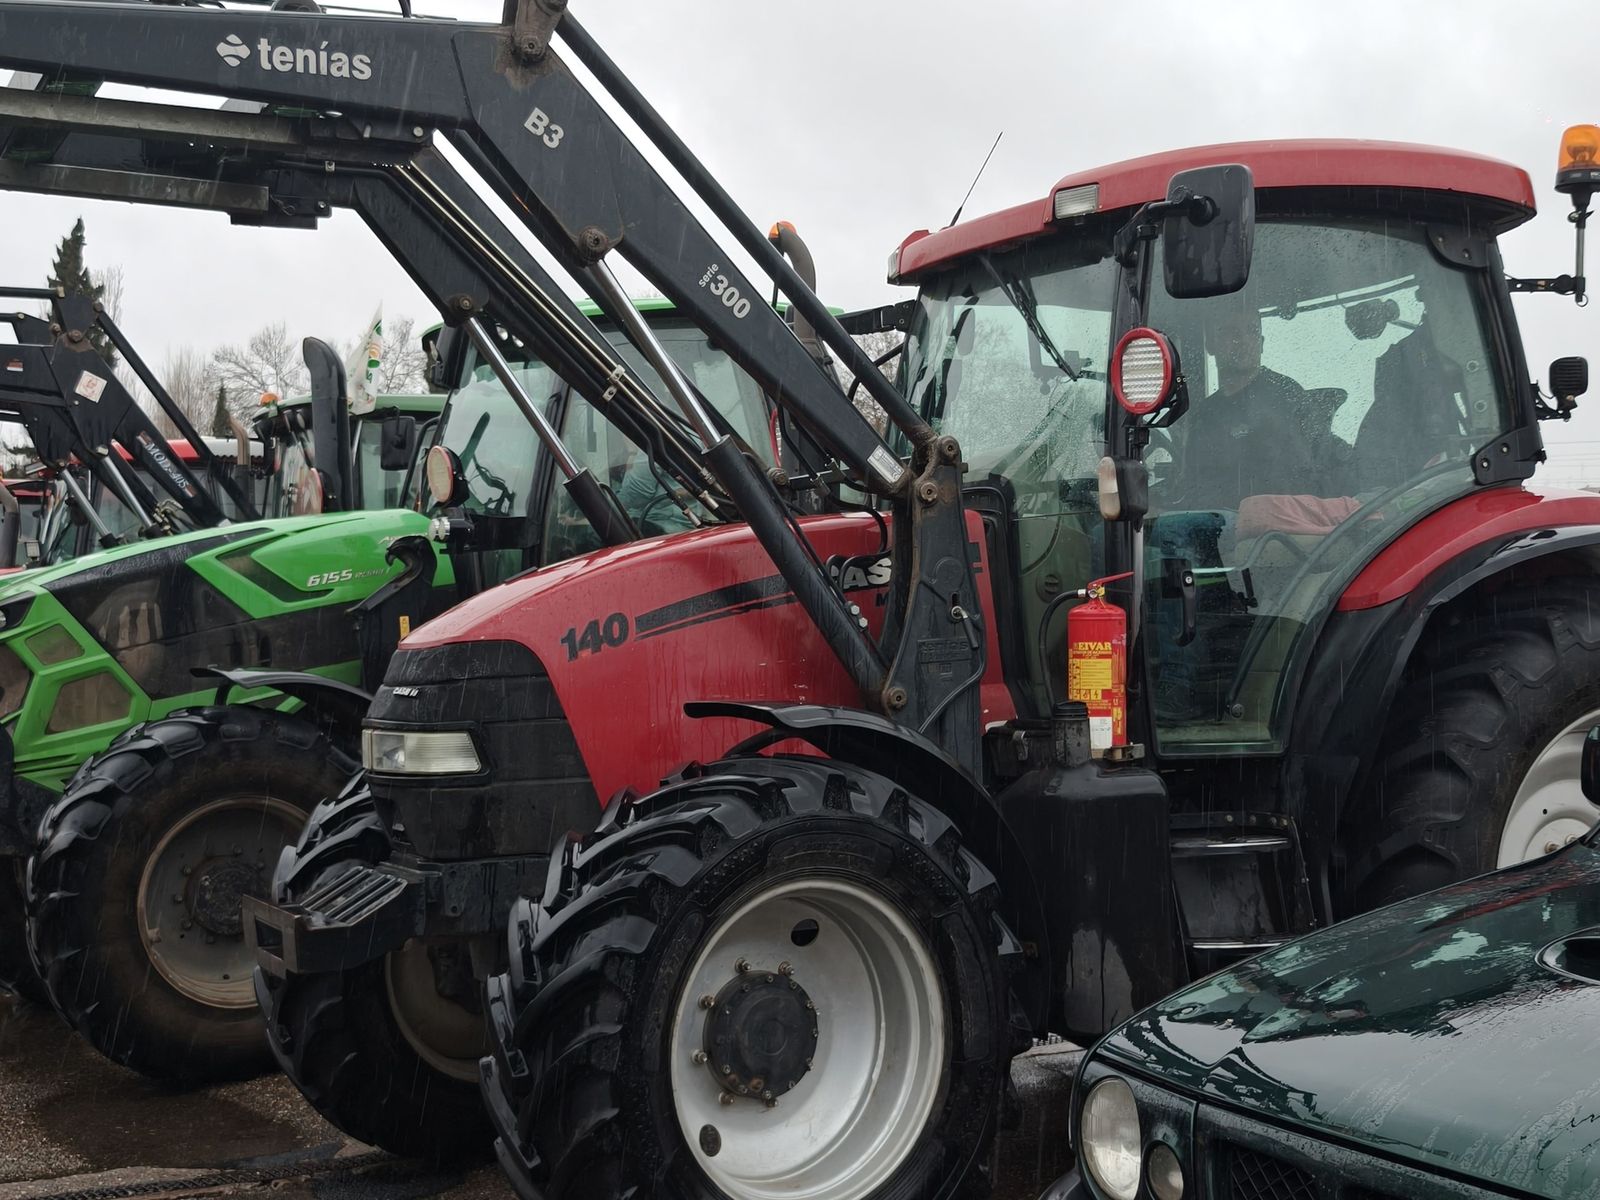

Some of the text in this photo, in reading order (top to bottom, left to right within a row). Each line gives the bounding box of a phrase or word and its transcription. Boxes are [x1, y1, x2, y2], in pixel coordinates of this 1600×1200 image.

[257, 38, 372, 80] tenías
[524, 107, 564, 149] B3
[698, 263, 719, 288] serie
[710, 274, 751, 319] 300
[306, 568, 353, 588] 6155
[560, 612, 629, 662] 140
[1078, 641, 1112, 651] EIVAR
